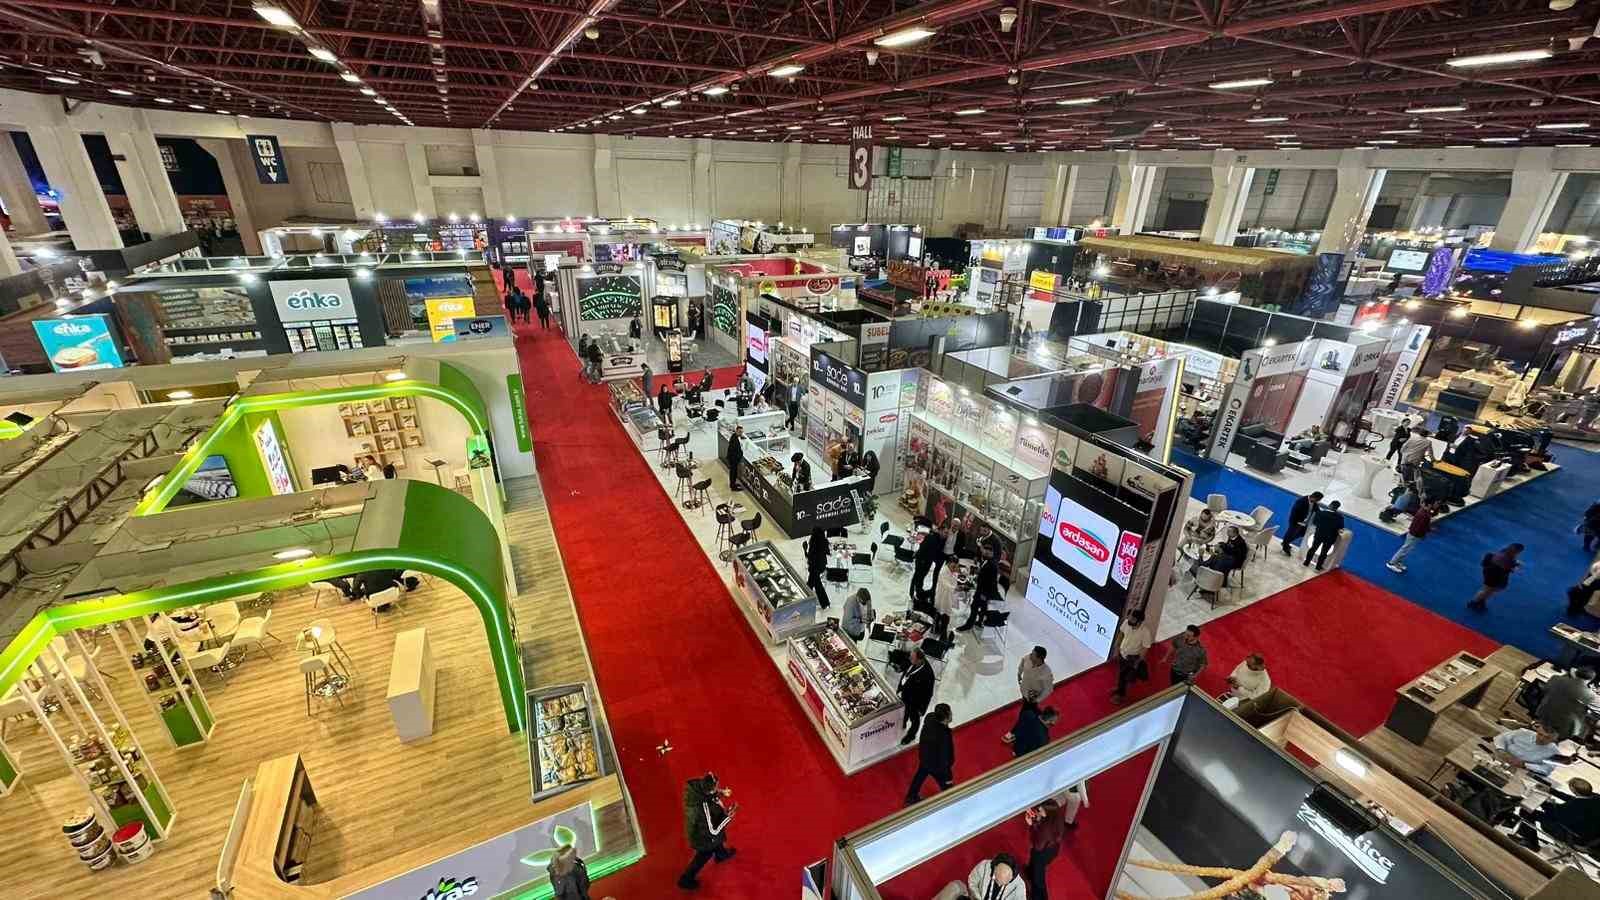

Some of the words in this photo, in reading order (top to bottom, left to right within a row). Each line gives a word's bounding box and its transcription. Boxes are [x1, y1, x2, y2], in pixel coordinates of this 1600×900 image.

[852, 125, 873, 139] HALL
[260, 157, 277, 166] WC
[854, 147, 869, 188] 3
[826, 366, 848, 386] sade
[872, 385, 885, 399] 10
[1217, 409, 1237, 449] EKARTEK
[816, 495, 852, 515] sade
[1062, 528, 1105, 559] ardasan
[1047, 586, 1090, 624] sade
